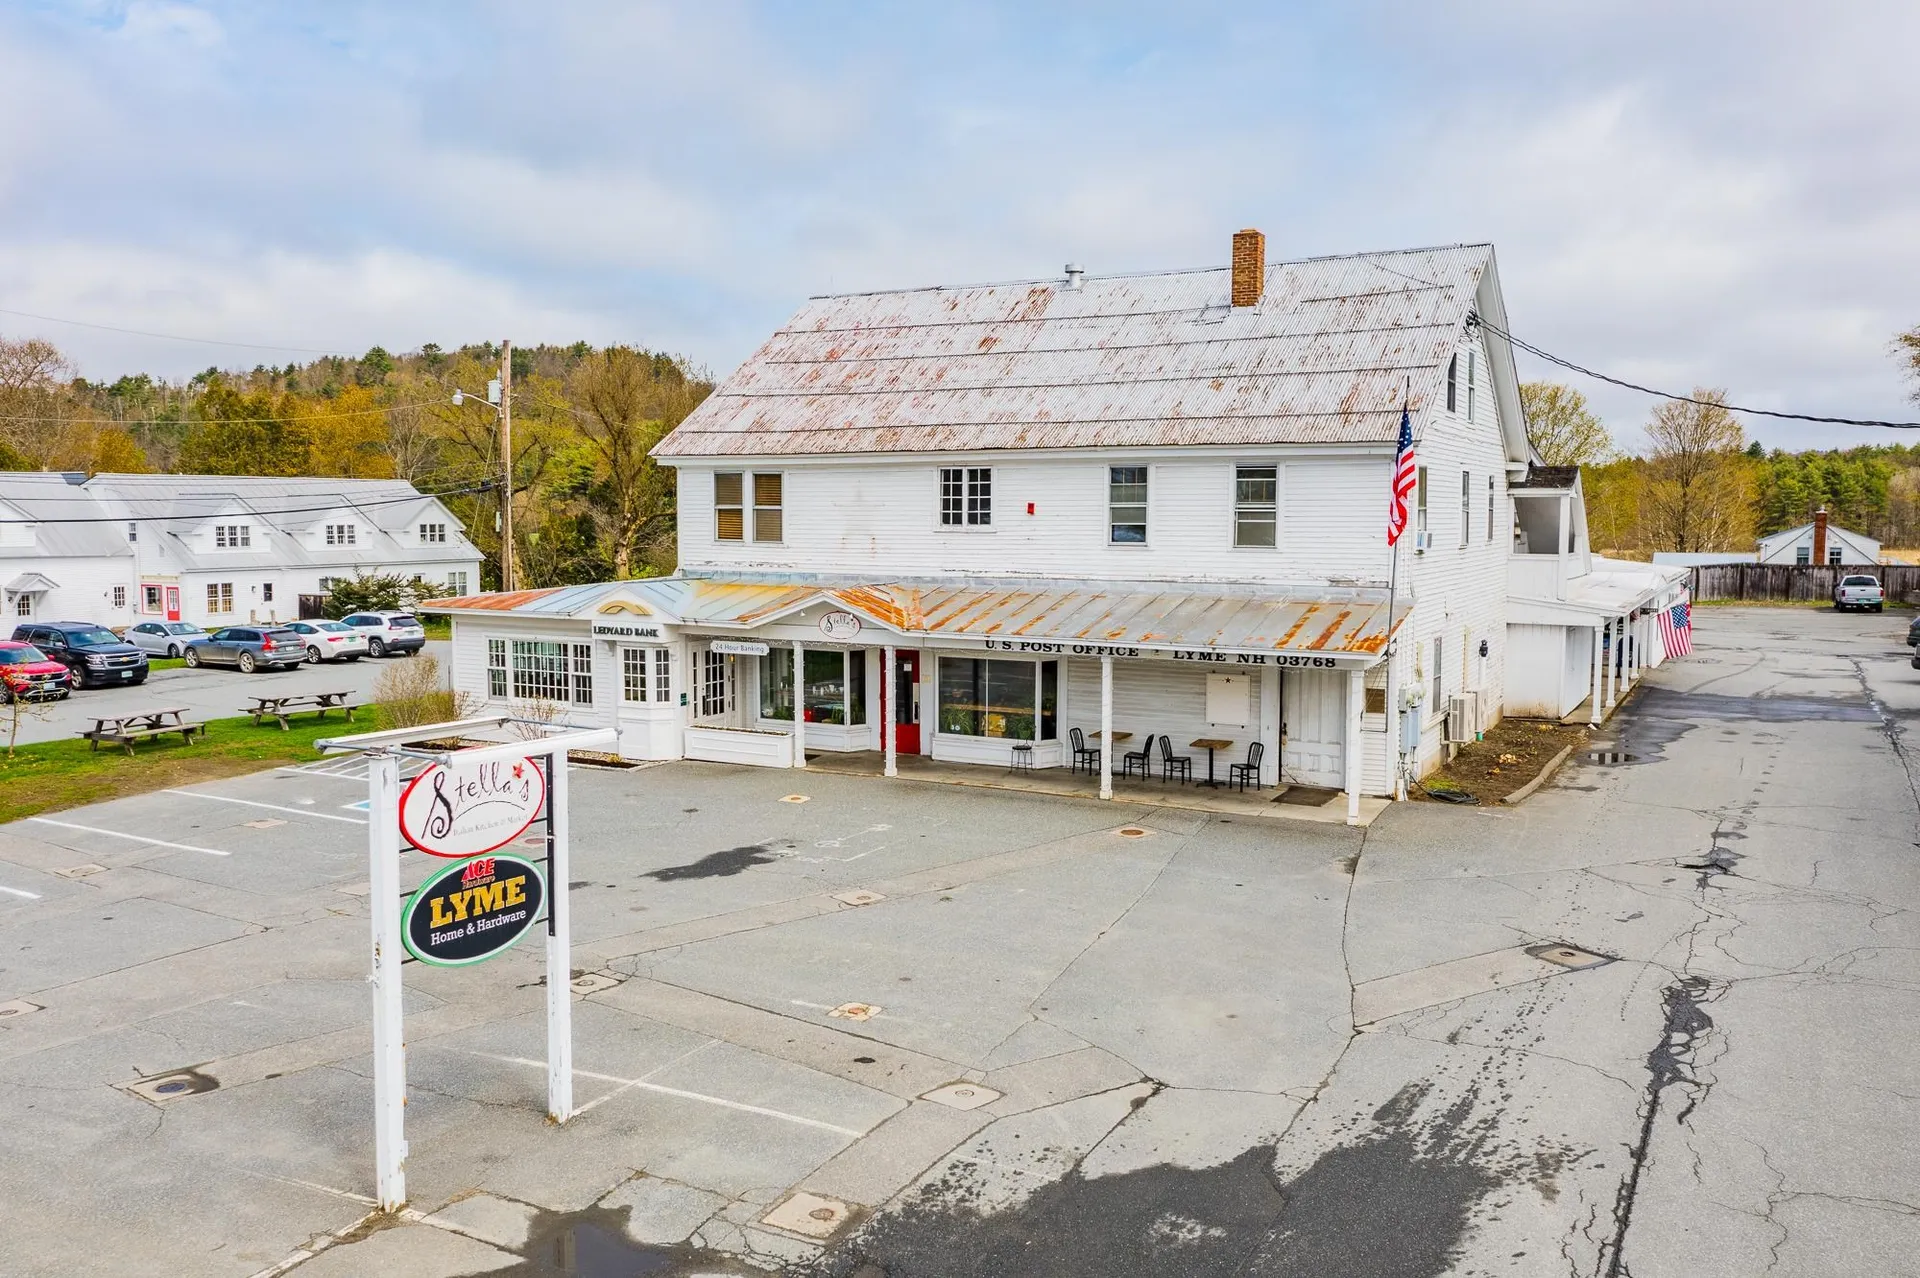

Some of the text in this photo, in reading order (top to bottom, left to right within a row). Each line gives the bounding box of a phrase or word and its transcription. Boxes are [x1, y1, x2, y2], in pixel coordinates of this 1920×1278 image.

[593, 626, 659, 638] LEDYARD BANK
[740, 645, 765, 653] Banking
[984, 640, 1139, 657] U. S. POST OFFICE
[1173, 650, 1336, 668] LYME NH 03768
[461, 857, 496, 882] ACE
[430, 875, 526, 929] LYME
[431, 910, 527, 946] Home & Hardware
